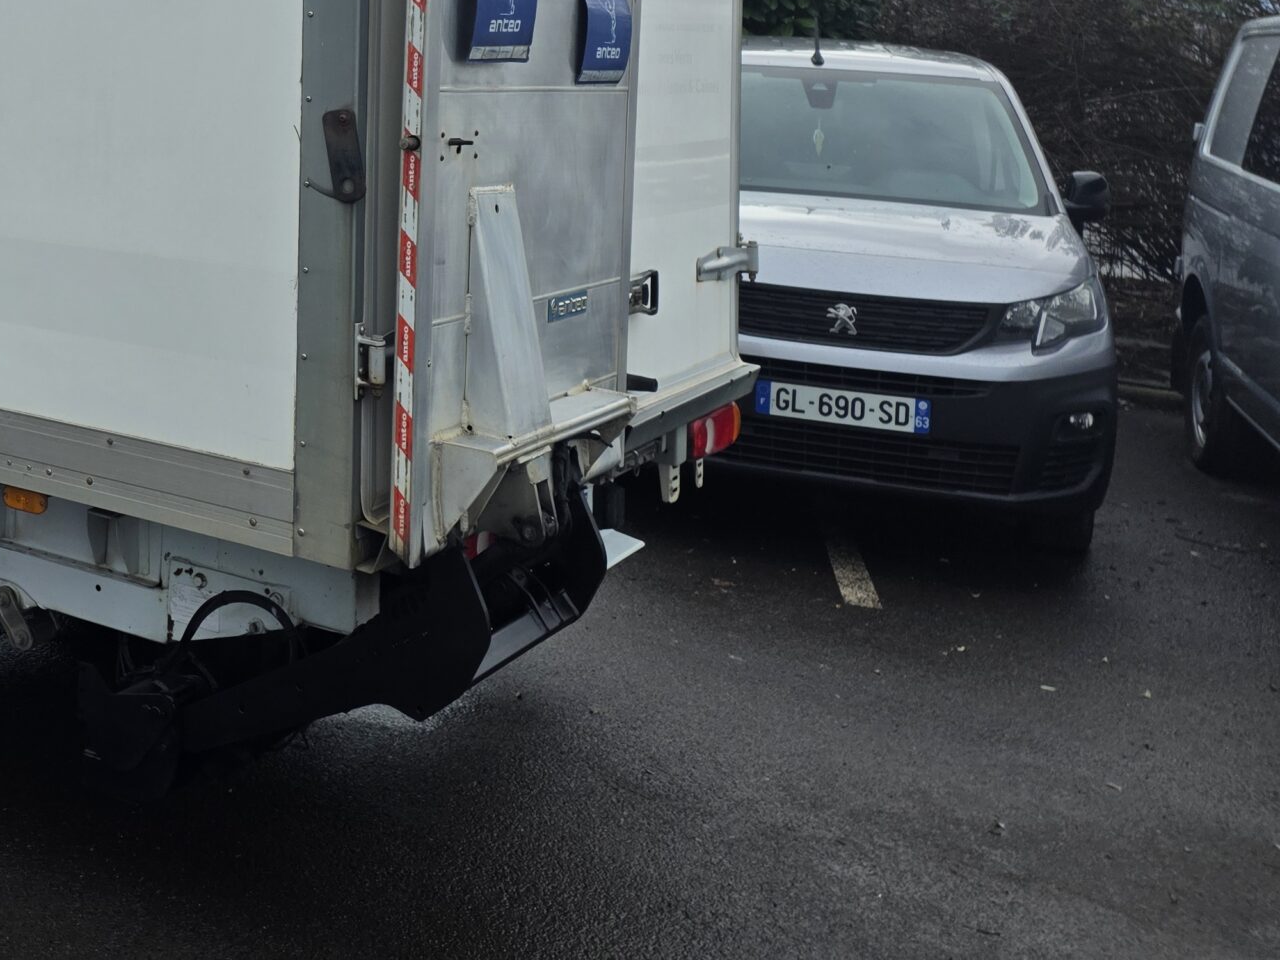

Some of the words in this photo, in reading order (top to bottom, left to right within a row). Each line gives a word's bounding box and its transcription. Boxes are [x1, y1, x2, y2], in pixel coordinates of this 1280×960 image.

[489, 19, 521, 33] anteo
[411, 52, 420, 88] anteo
[596, 46, 621, 59] anteo
[404, 240, 412, 277] anteo
[401, 325, 409, 362] anteo
[775, 387, 911, 427] GL-690-SD
[915, 417, 930, 429] 63
[400, 413, 408, 450] anteo
[398, 499, 406, 536] anteo
